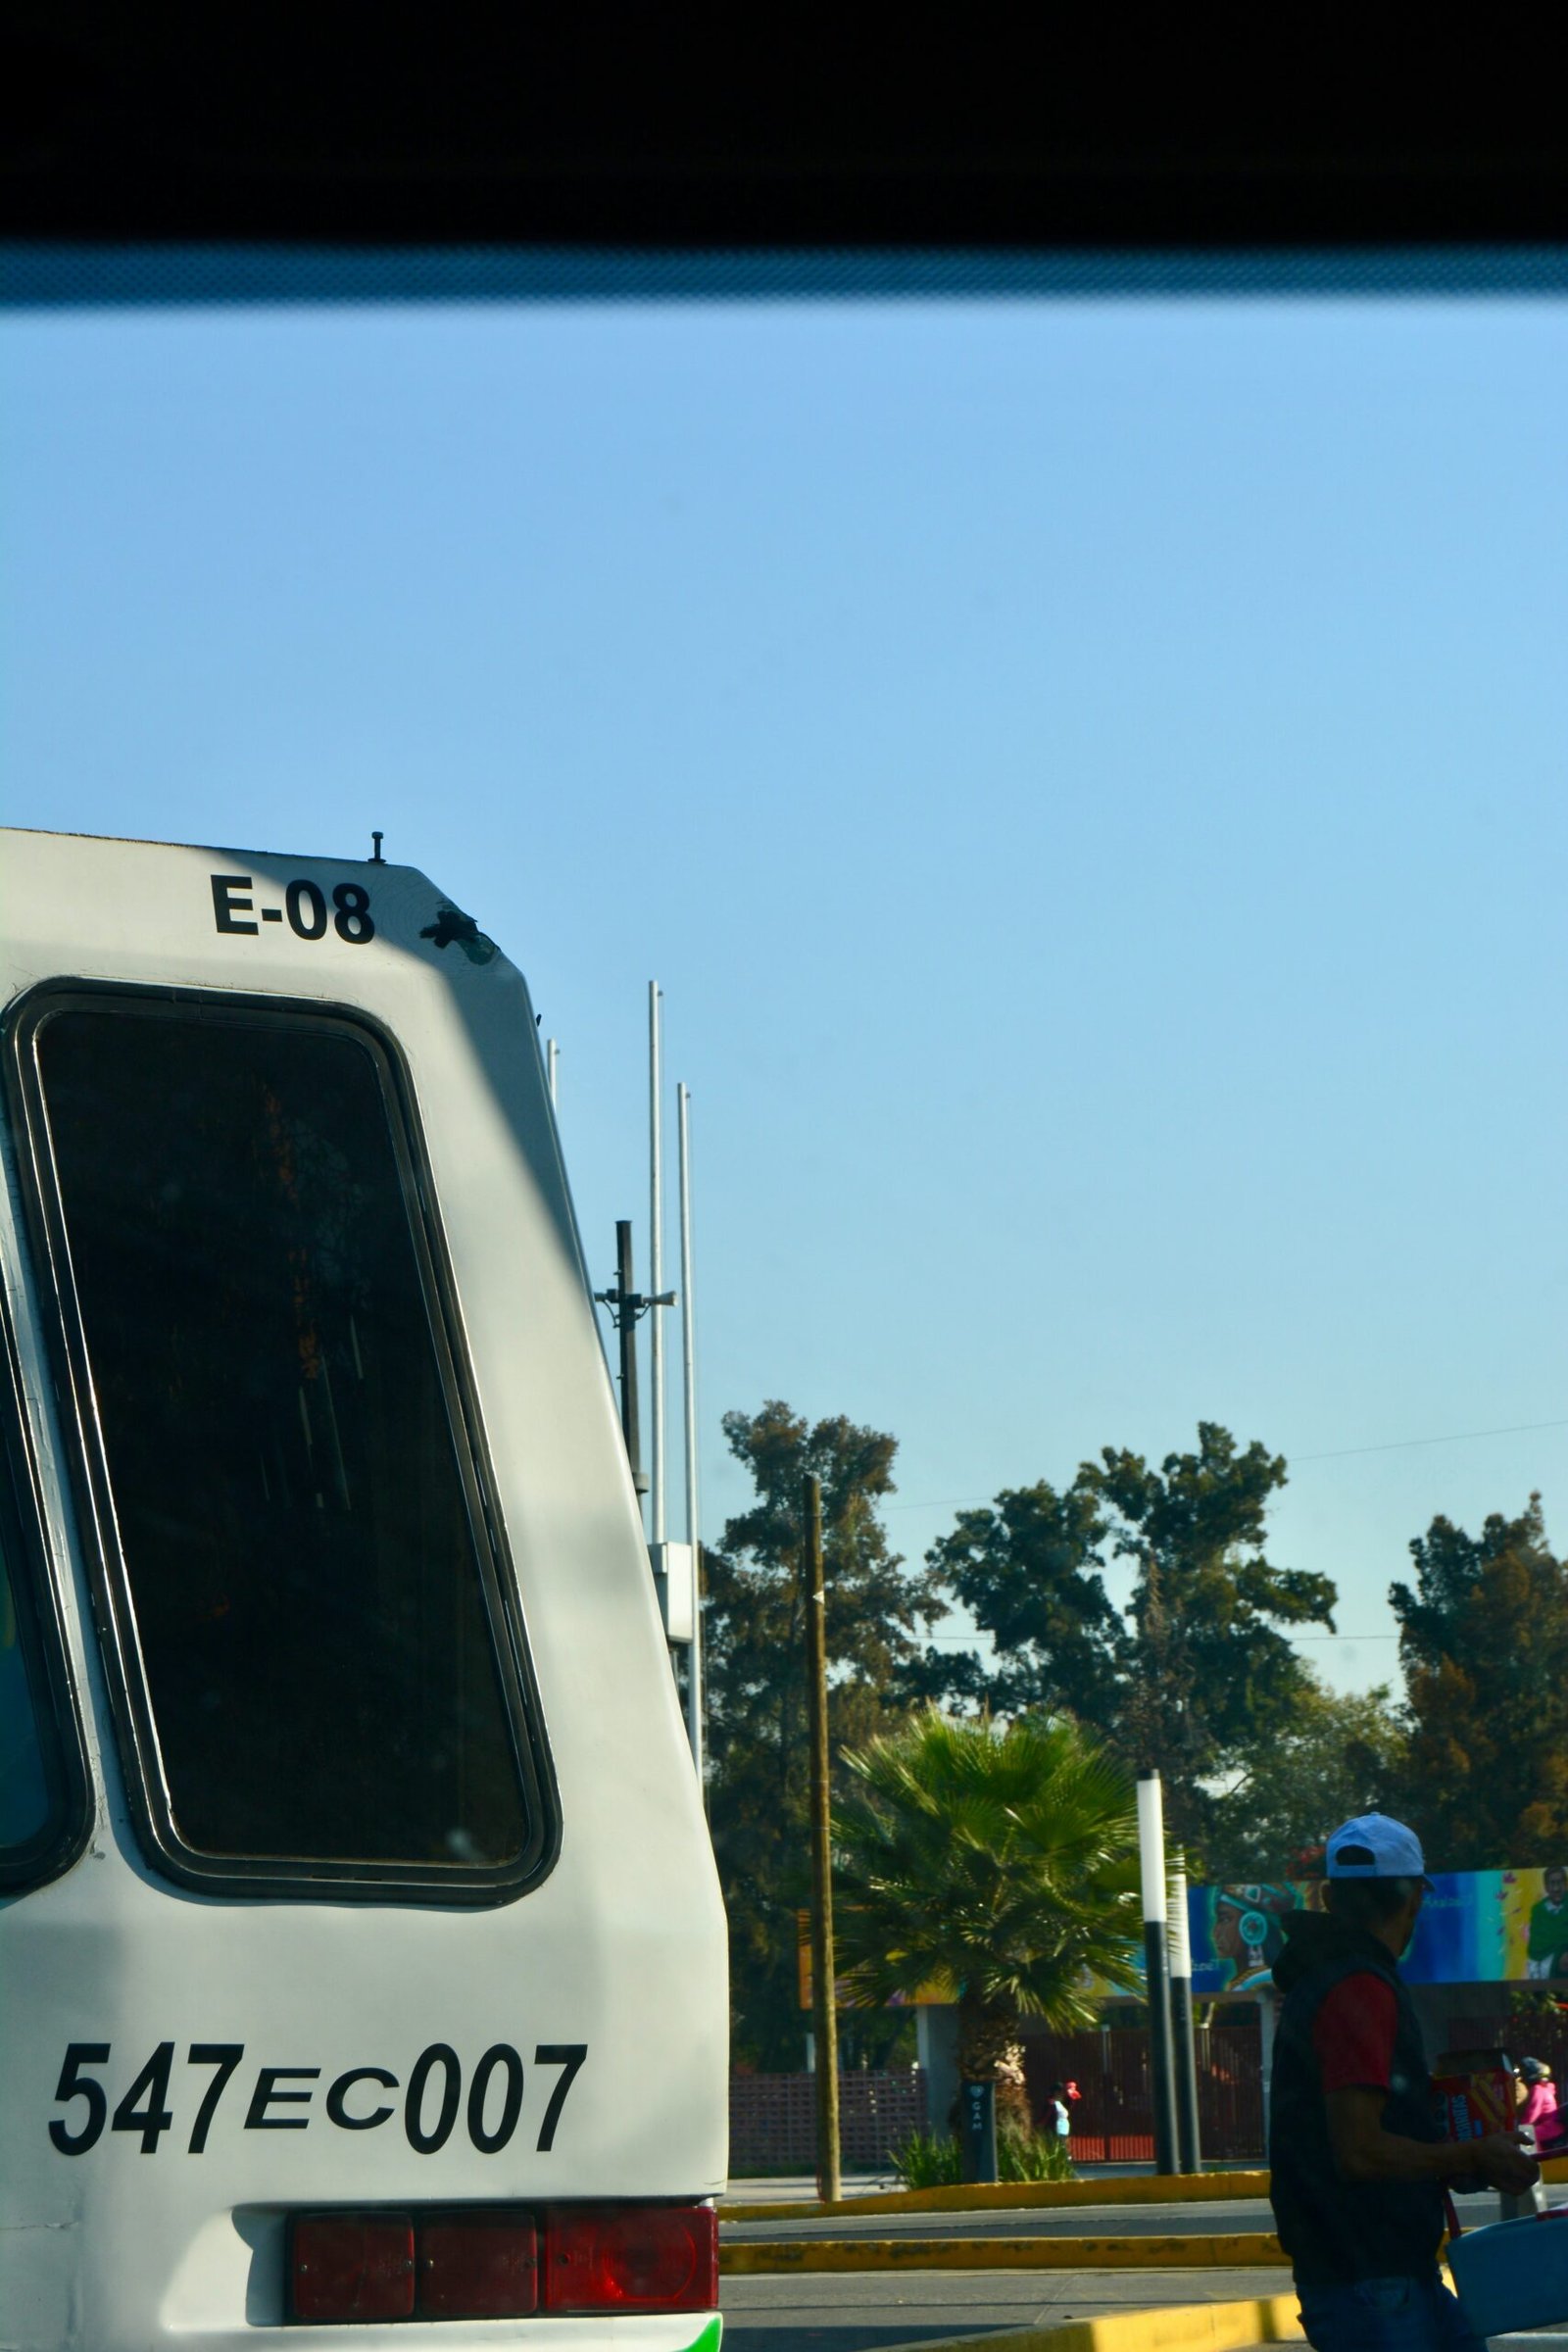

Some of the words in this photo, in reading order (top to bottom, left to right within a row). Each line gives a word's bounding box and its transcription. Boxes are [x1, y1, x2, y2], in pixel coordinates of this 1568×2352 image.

[210, 874, 377, 945] E-08
[48, 2041, 589, 2157] 547EC007
[972, 2101, 983, 2131] GAM
